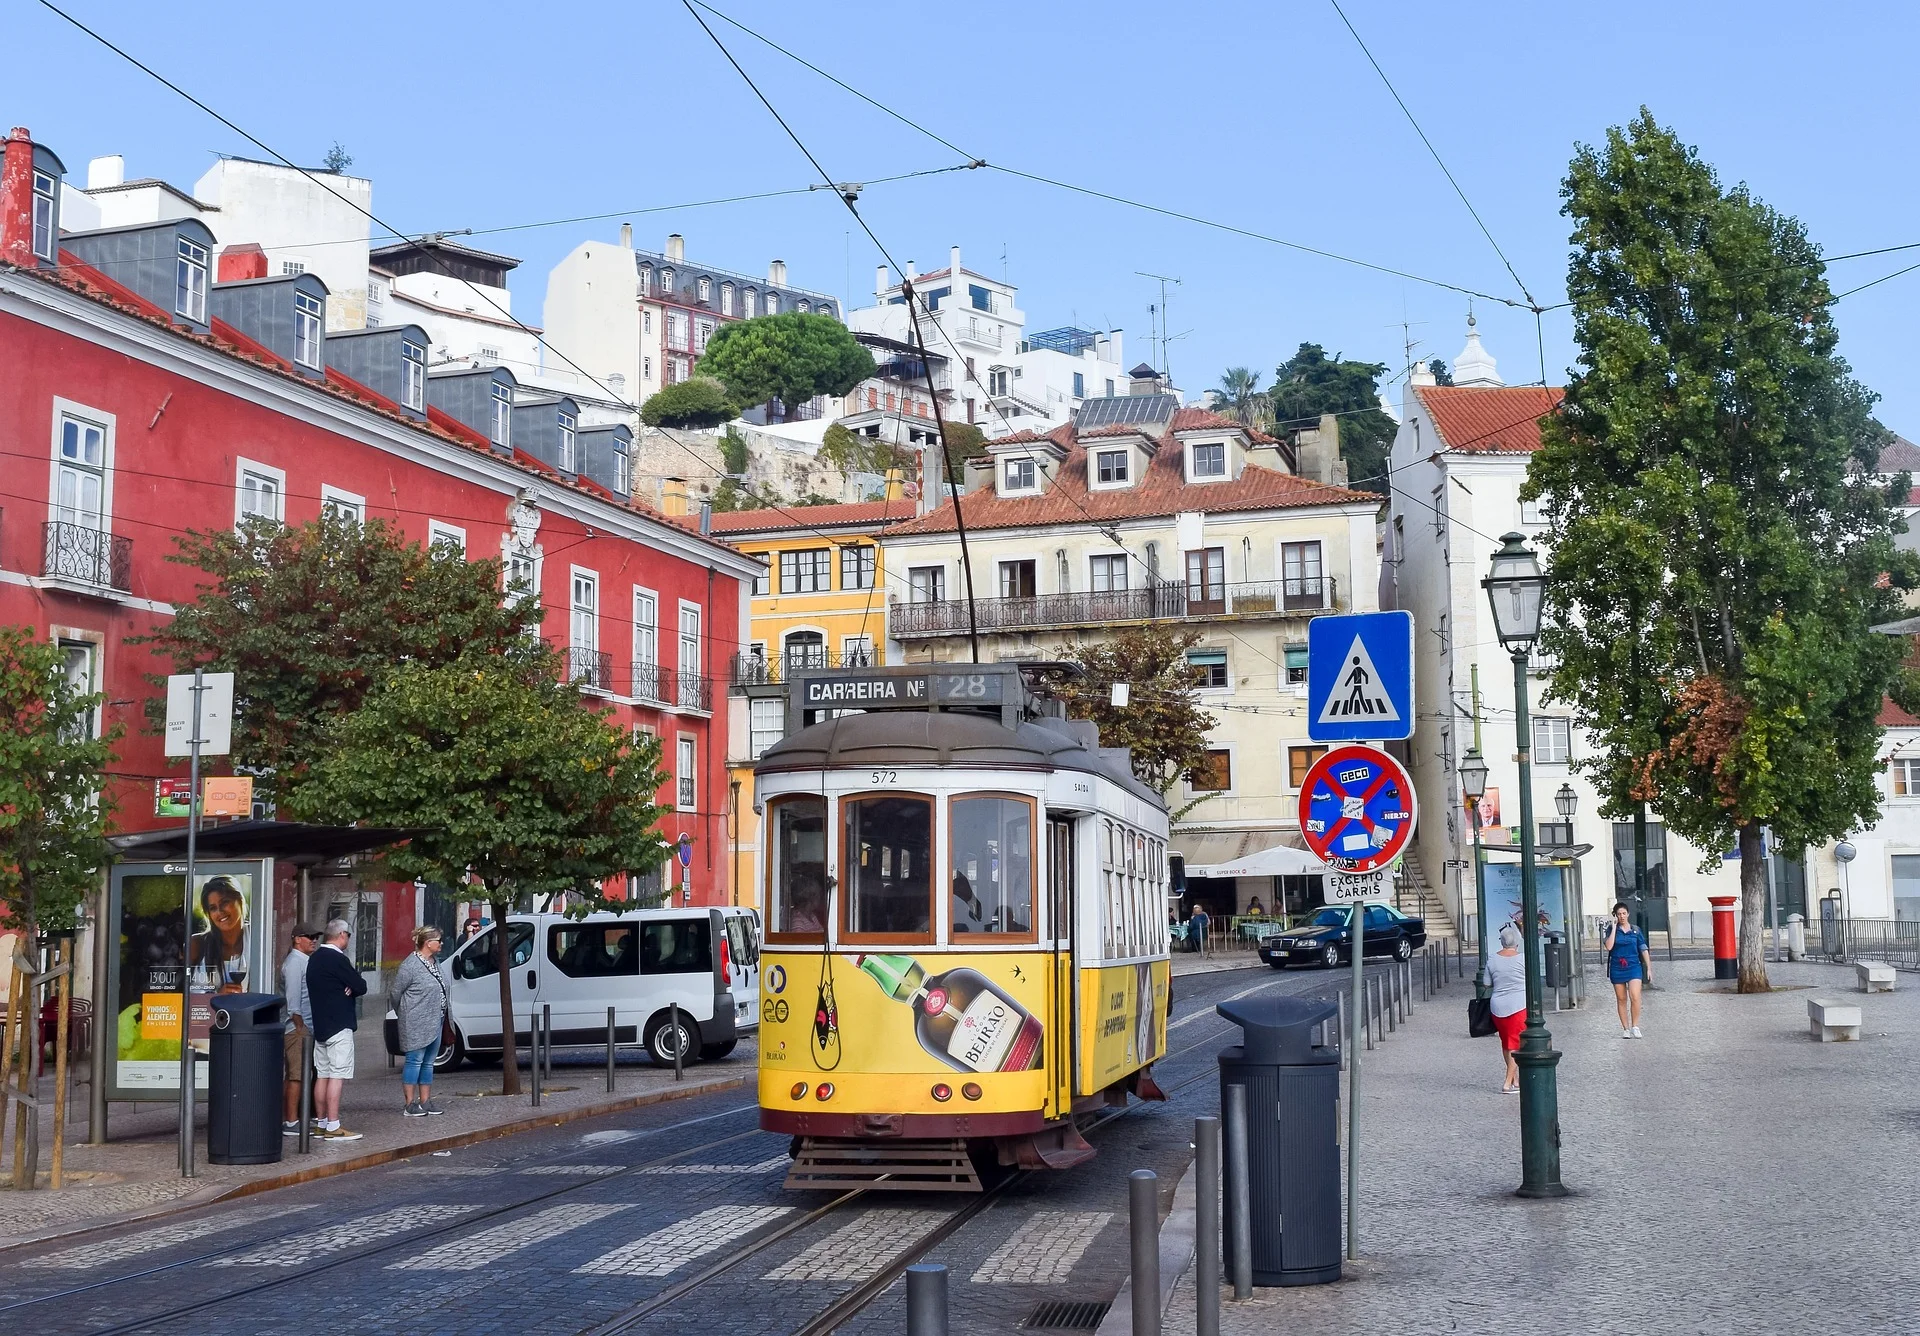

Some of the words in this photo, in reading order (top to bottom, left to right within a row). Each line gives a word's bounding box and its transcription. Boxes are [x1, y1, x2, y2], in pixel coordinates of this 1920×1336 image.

[809, 681, 896, 700] CARREIRA
[949, 674, 986, 697] 28
[872, 772, 896, 784] 572
[1336, 885, 1380, 898] CARRIS
[150, 972, 157, 983] 13
[159, 972, 176, 983] OUT
[190, 972, 196, 983] 14
[199, 972, 216, 983] OUT
[964, 1005, 1005, 1064] BEIRÃO
